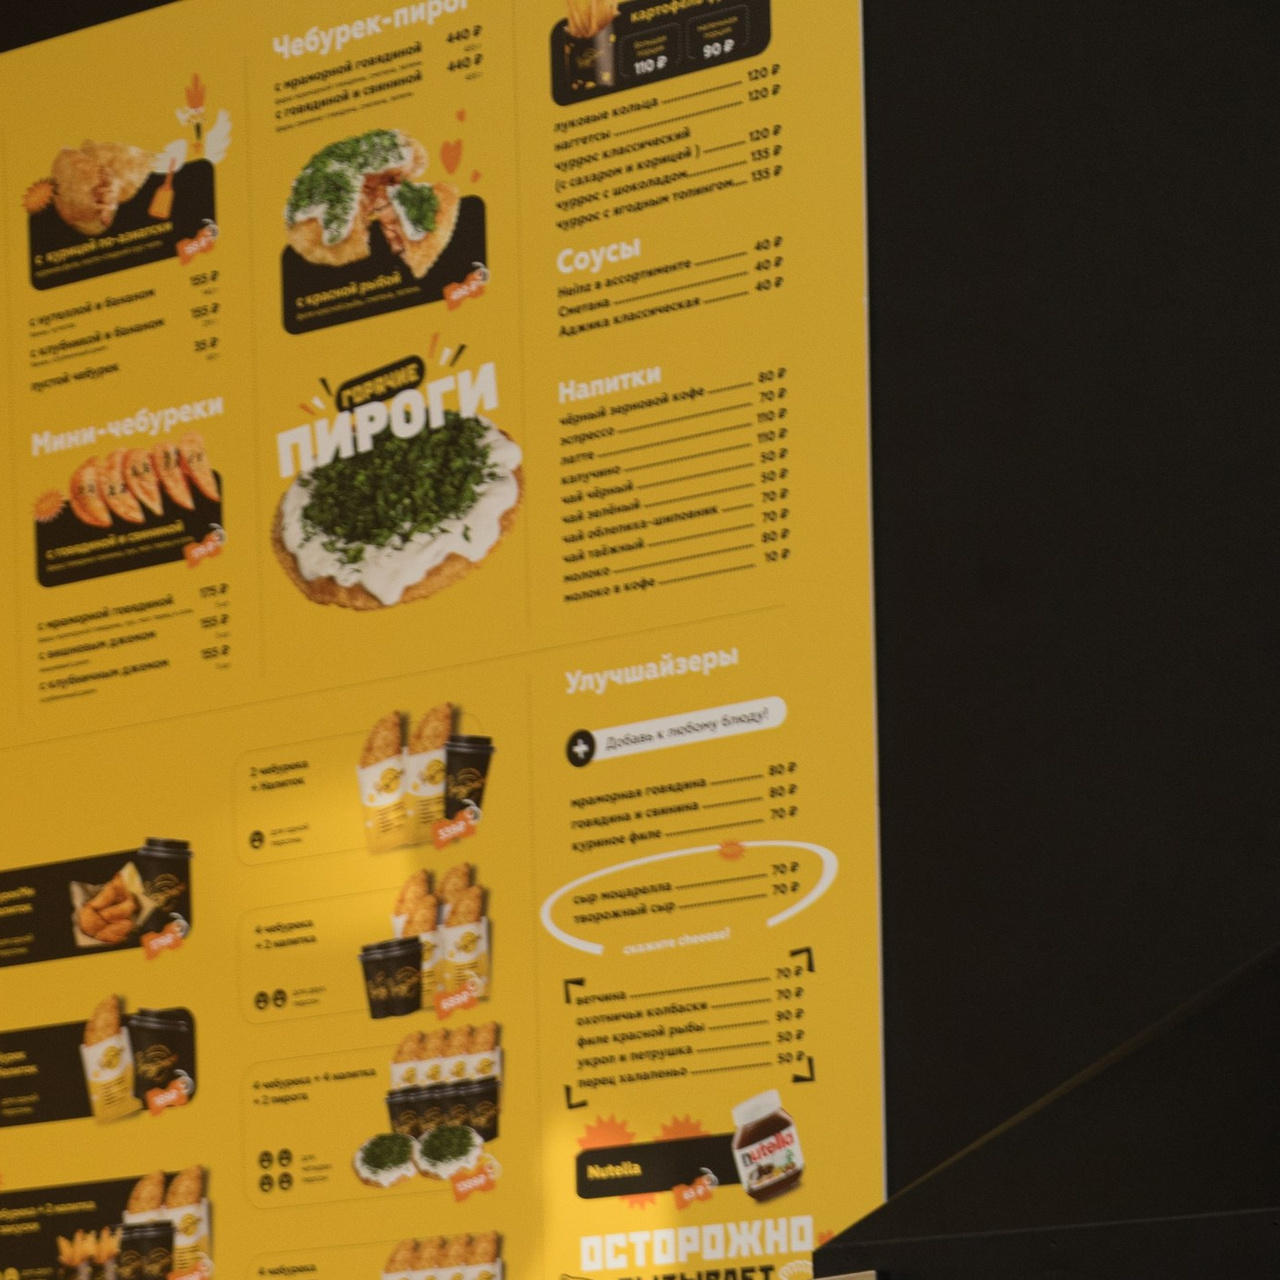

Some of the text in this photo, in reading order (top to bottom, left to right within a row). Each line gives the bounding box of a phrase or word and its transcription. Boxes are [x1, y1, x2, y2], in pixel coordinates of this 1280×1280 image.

[355, 41, 423, 69] говядиной
[447, 28, 470, 43] 440
[633, 55, 668, 76] 110 ₽
[703, 39, 735, 59] 90 ₽
[284, 91, 350, 115] говядиной
[363, 70, 423, 96] свининой
[447, 57, 471, 72] 440
[553, 67, 768, 133] луковые кольца 120
[554, 87, 769, 152] наггетсы 120
[553, 126, 692, 173] чуррос классический
[569, 167, 623, 189] сахаром
[636, 149, 692, 171] корицей
[749, 127, 770, 143] 120
[555, 191, 600, 212] чуррос
[555, 211, 601, 232] чуррос
[613, 195, 670, 218] ягодным
[556, 238, 641, 274] Соусы
[557, 238, 771, 298] Heinz ассортименте 40
[558, 259, 771, 318] Сметана 40
[559, 279, 772, 337] Аджика классическая 40
[558, 366, 662, 405] Напитки
[610, 392, 670, 416] зерновой
[672, 387, 705, 402] кофе
[31, 397, 224, 457] Мини-чебуреки
[276, 361, 499, 479] ПИРОГИ
[560, 390, 775, 447] эспрессо 70
[560, 410, 775, 466] латте 110
[560, 430, 776, 486] капучино 110
[560, 490, 584, 505] чай
[561, 510, 584, 525] чай
[562, 530, 585, 544] чай
[761, 490, 778, 503] 70
[563, 549, 586, 564] чай
[762, 510, 778, 523] 70
[563, 567, 610, 583] молоко
[563, 586, 610, 603] молоко
[623, 577, 655, 593] кофе
[565, 647, 739, 695] Улучшайзеры
[604, 707, 769, 752] Добавь любому блюду!
[571, 788, 643, 809] мраморная
[645, 777, 707, 798] говядина
[571, 812, 632, 830] говядина
[645, 801, 700, 818] свинина
[571, 807, 786, 853] куриное филе 70
[572, 892, 598, 906] сыр
[771, 862, 788, 876] 70
[574, 882, 788, 925] творожный сыр 70
[576, 967, 791, 1006] ветчина 70
[646, 1000, 708, 1018] колбаски
[776, 988, 792, 1000] 70
[577, 1032, 610, 1048] филе
[612, 1024, 667, 1044] красной
[668, 1021, 706, 1036] рыбы
[577, 1054, 617, 1070] укроп
[630, 1044, 694, 1062] петрушка
[578, 1074, 616, 1090] перец
[619, 1066, 688, 1084] халапеньо
[742, 1129, 795, 1168] nutella
[586, 1161, 643, 1181] Nutella
[579, 1214, 814, 1273] ОСТОРОЖНО
